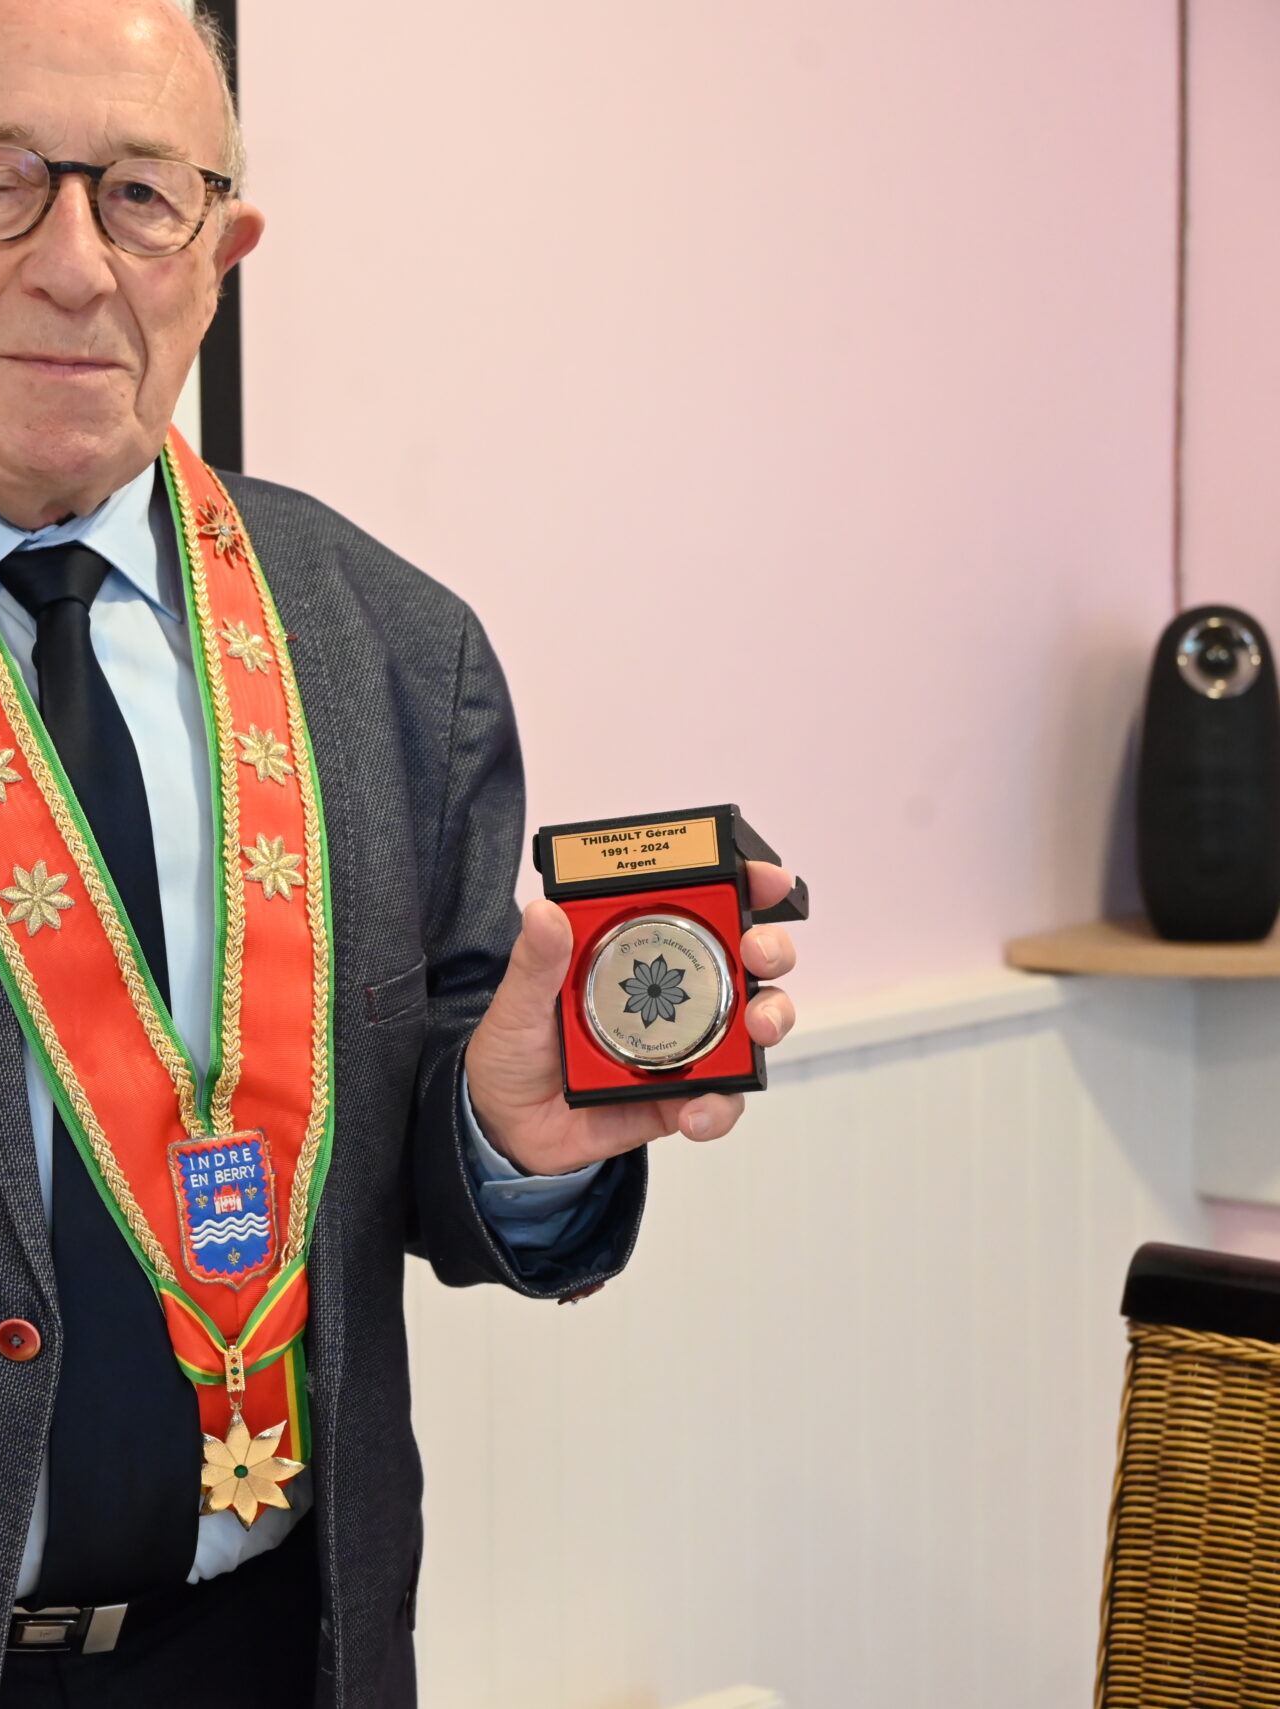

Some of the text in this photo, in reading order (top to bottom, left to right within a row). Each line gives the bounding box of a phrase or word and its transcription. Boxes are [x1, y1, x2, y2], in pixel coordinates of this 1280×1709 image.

[581, 826, 687, 846] THIBAULT Gérard
[601, 847, 629, 857] 1991
[640, 842, 670, 853] 2024
[616, 858, 657, 870] Argent
[619, 931, 706, 971] Ordre International
[613, 1027, 625, 1039] des
[189, 1147, 253, 1171] INDRE
[190, 1164, 256, 1188] EN BERRY
